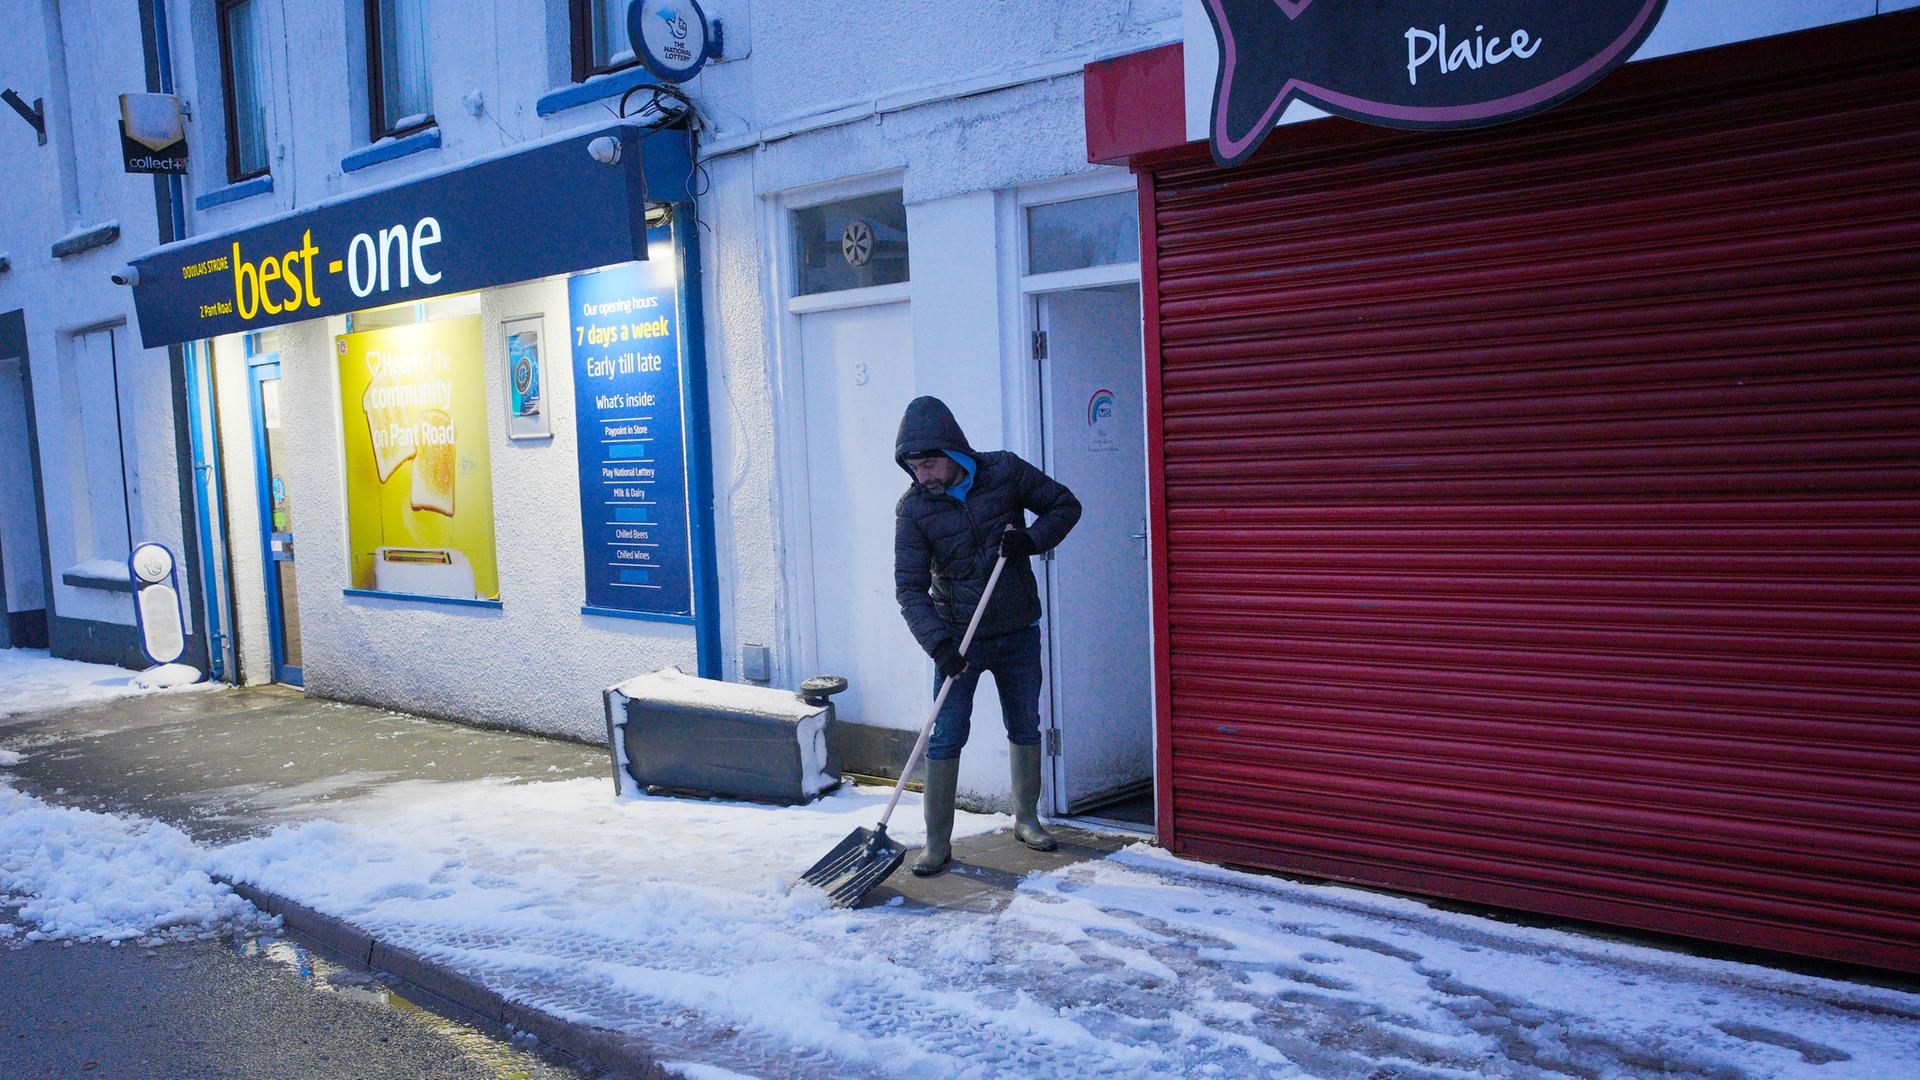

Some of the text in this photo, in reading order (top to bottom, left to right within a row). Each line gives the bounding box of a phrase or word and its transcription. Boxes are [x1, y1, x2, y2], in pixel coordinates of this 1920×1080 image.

[664, 46, 692, 56] NATIONAL
[665, 53, 690, 61] LOTTERY
[1404, 24, 1543, 86] Plaice
[199, 299, 233, 319] 2 Pant Road
[584, 296, 659, 317] Our opening hours:
[576, 315, 669, 348] 7 days a week
[380, 351, 419, 376] Heart
[587, 352, 662, 380] Early till late
[855, 360, 868, 386] 3
[371, 378, 452, 411] community
[595, 392, 656, 410] What's inside:
[373, 418, 456, 449] on Pant Road
[604, 425, 649, 437] Paypoint in Store
[602, 467, 655, 479] Play National Lottery
[613, 488, 645, 499] Milk & Dairy
[616, 529, 648, 539] Chilled Beers
[616, 549, 650, 560] Chilled Wines
